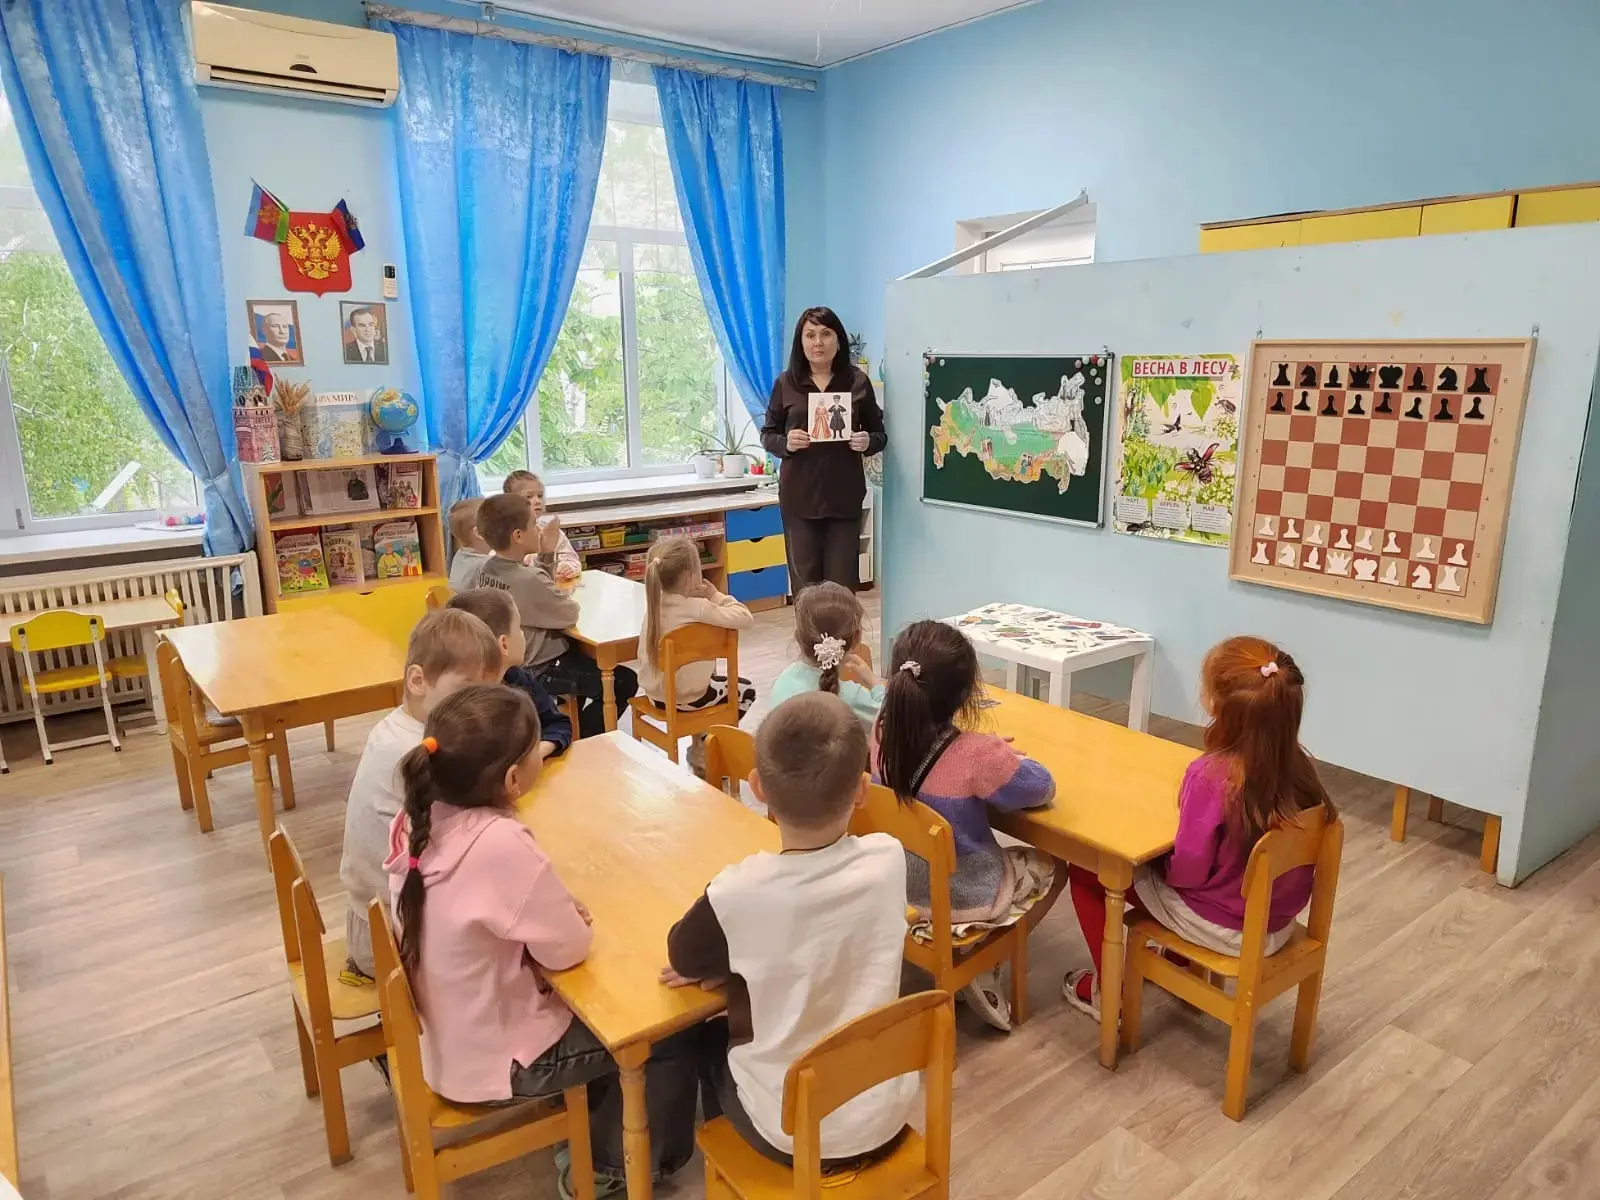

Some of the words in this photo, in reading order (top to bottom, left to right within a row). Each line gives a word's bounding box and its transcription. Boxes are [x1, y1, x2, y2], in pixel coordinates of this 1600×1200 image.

[1135, 361, 1175, 375] ВЕСНА
[1179, 362, 1188, 375] В
[1192, 360, 1228, 375] ЛЕСУ
[332, 394, 358, 402] МИРА
